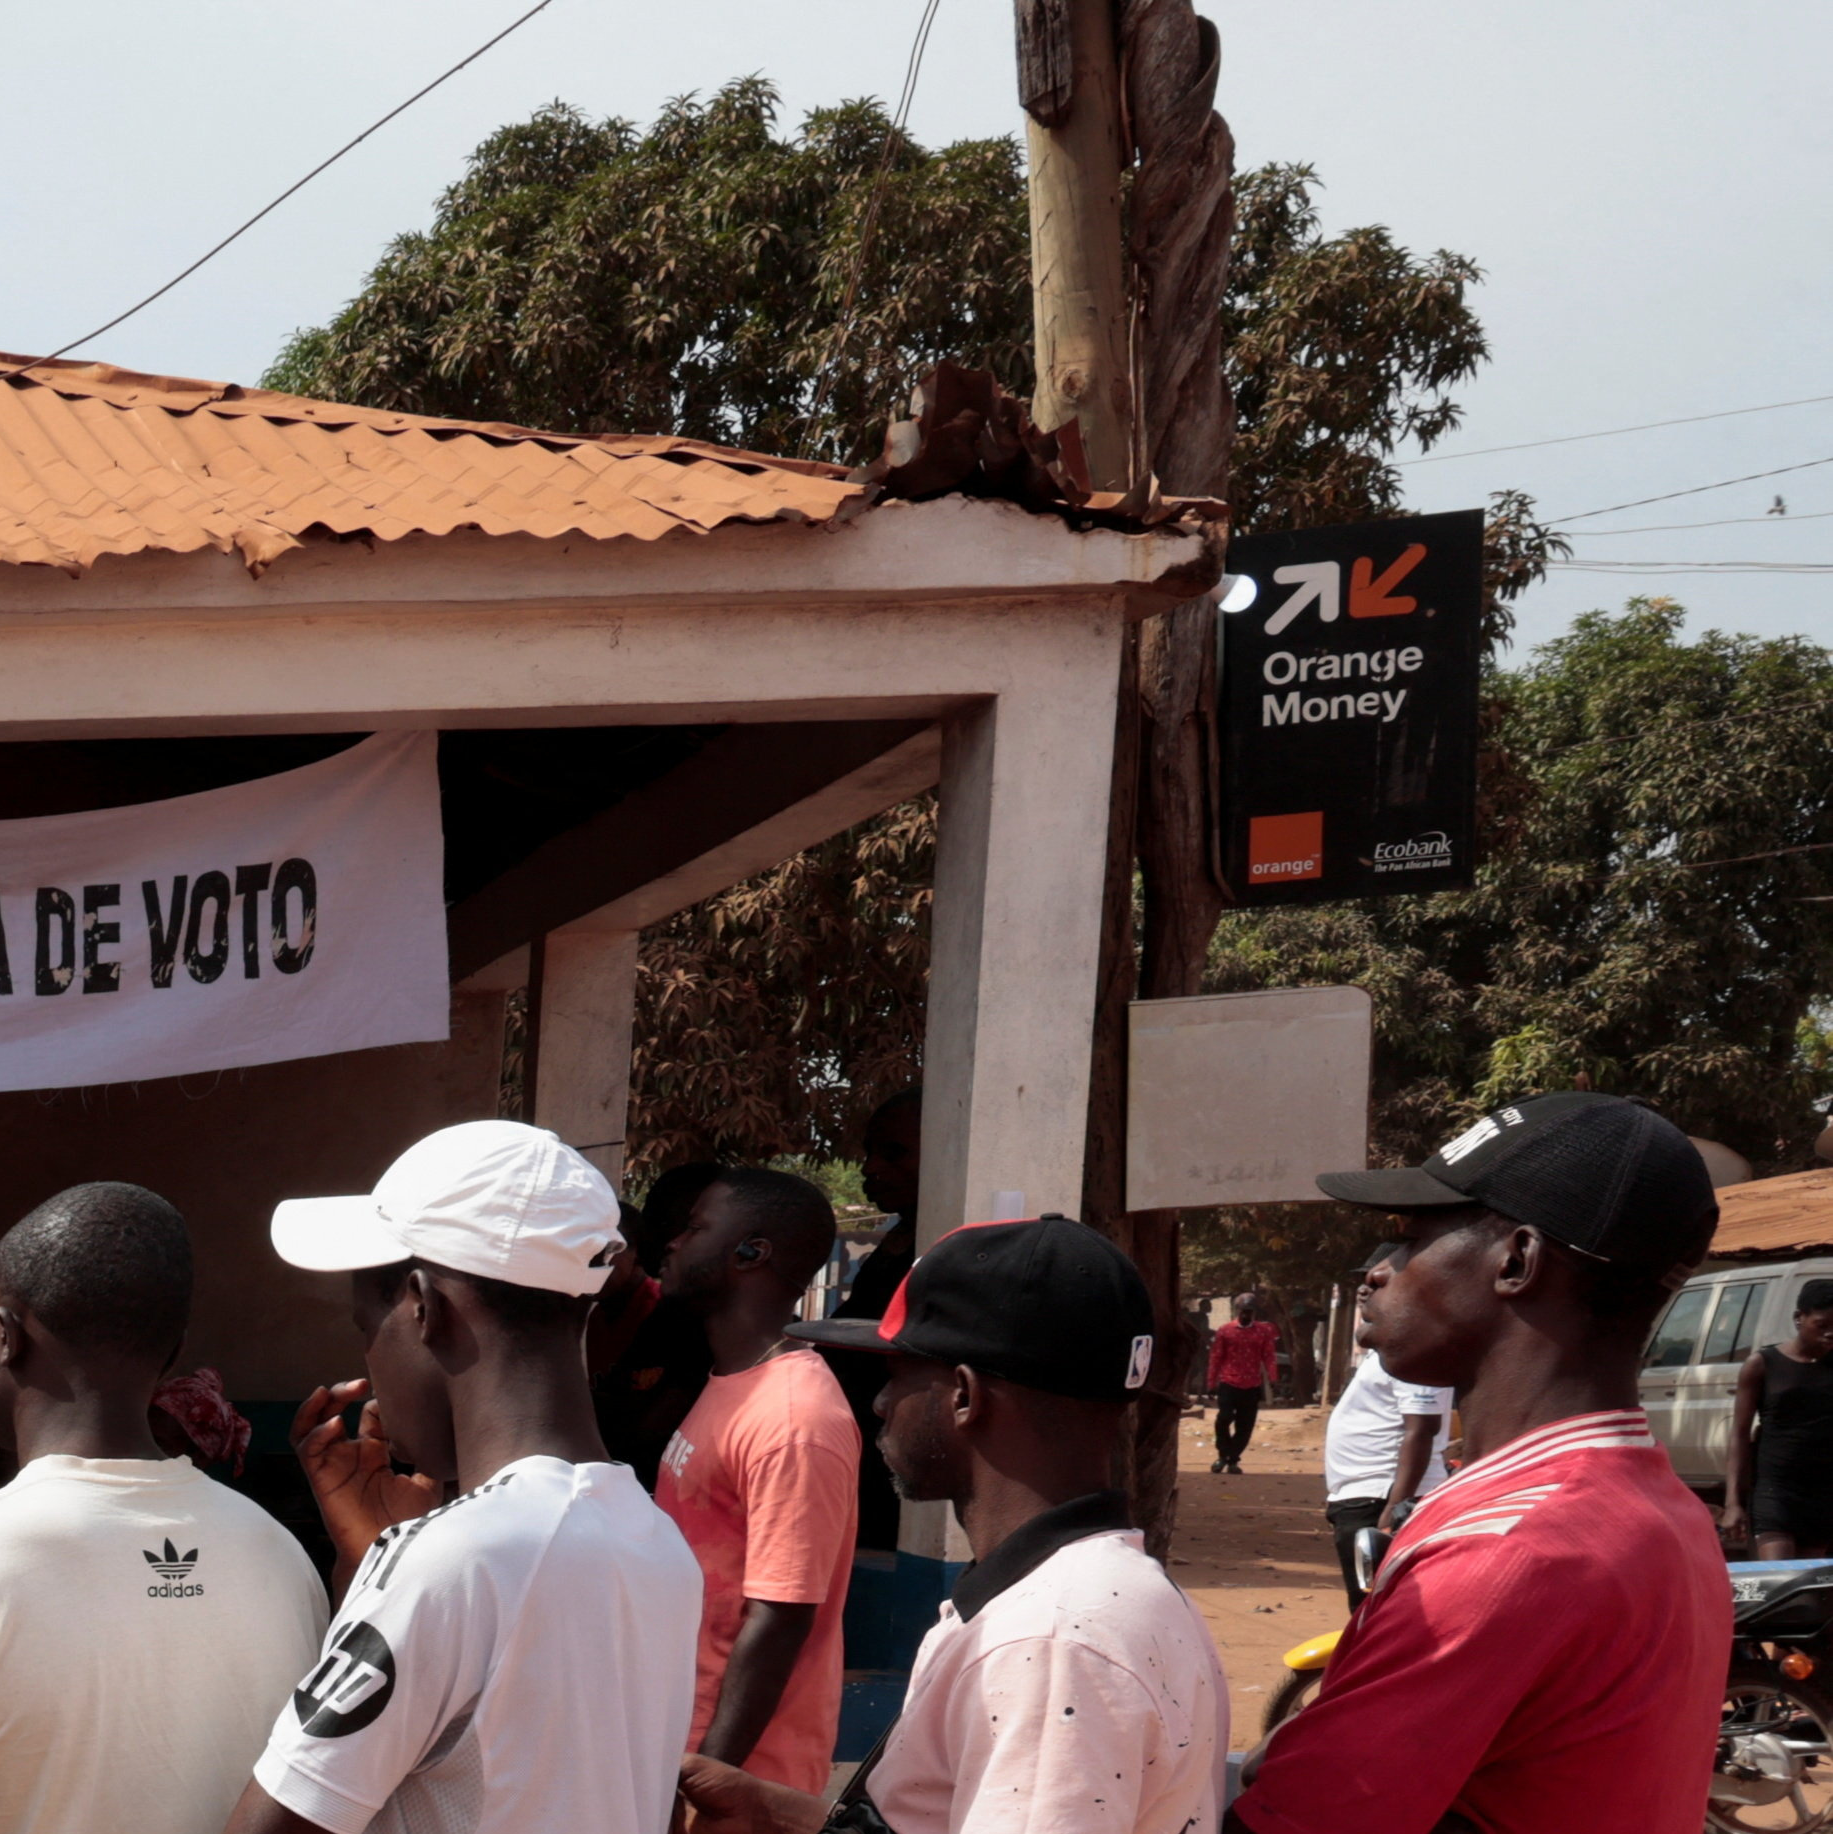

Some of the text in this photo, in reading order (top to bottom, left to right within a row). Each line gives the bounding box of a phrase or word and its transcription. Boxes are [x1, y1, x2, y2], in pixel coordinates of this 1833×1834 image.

[1262, 645, 1424, 687] Orange
[1262, 688, 1408, 727] Money
[1374, 831, 1453, 859] Ecobank
[1252, 858, 1314, 876] orange
[35, 883, 122, 997] DE
[142, 857, 318, 990] VOTO
[147, 1582, 205, 1599] adidas
